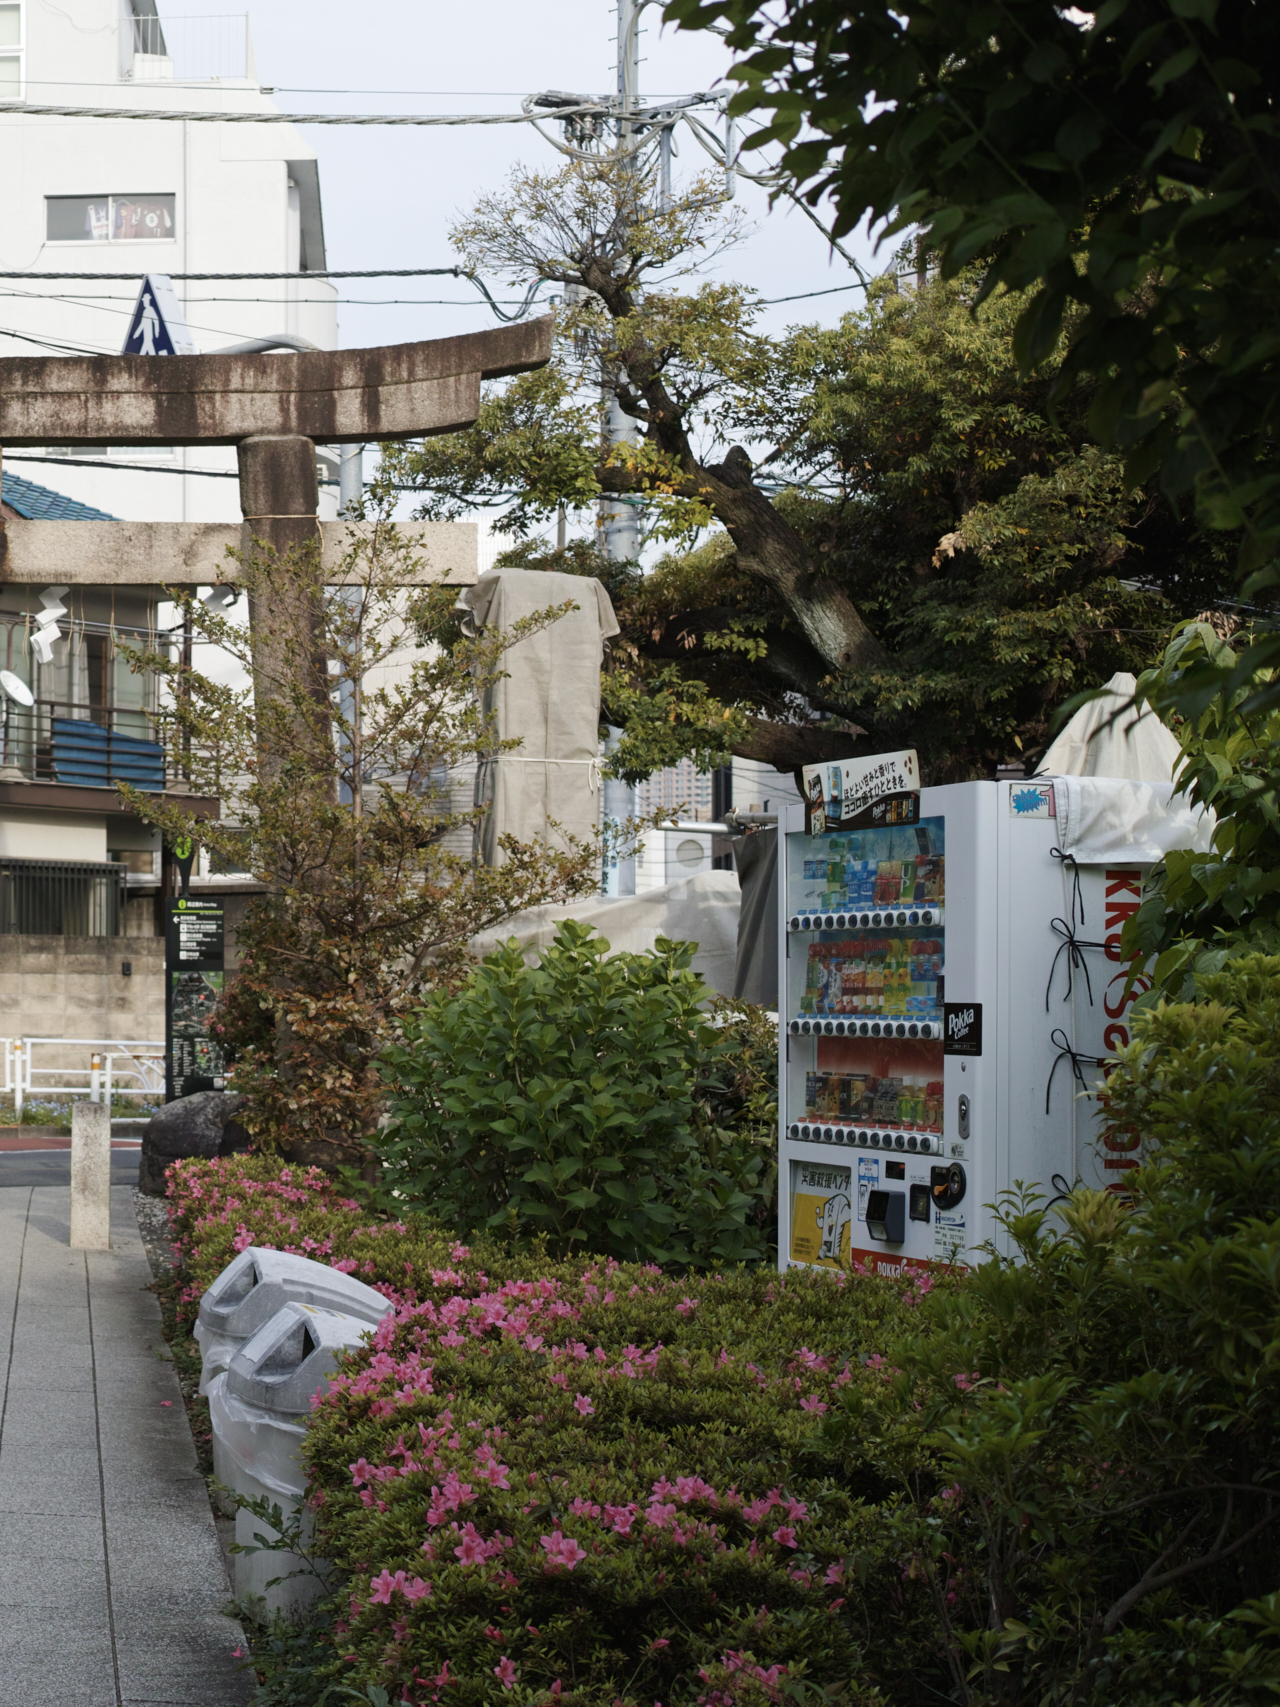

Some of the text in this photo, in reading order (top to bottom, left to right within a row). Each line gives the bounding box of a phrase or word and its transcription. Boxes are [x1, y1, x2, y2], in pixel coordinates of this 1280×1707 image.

[844, 761, 897, 800] ほどよい甘みと香りで
[948, 1008, 974, 1036] Pokka
[954, 1026, 970, 1040] Coffee
[801, 1164, 851, 1191] 災害救援ベンダ
